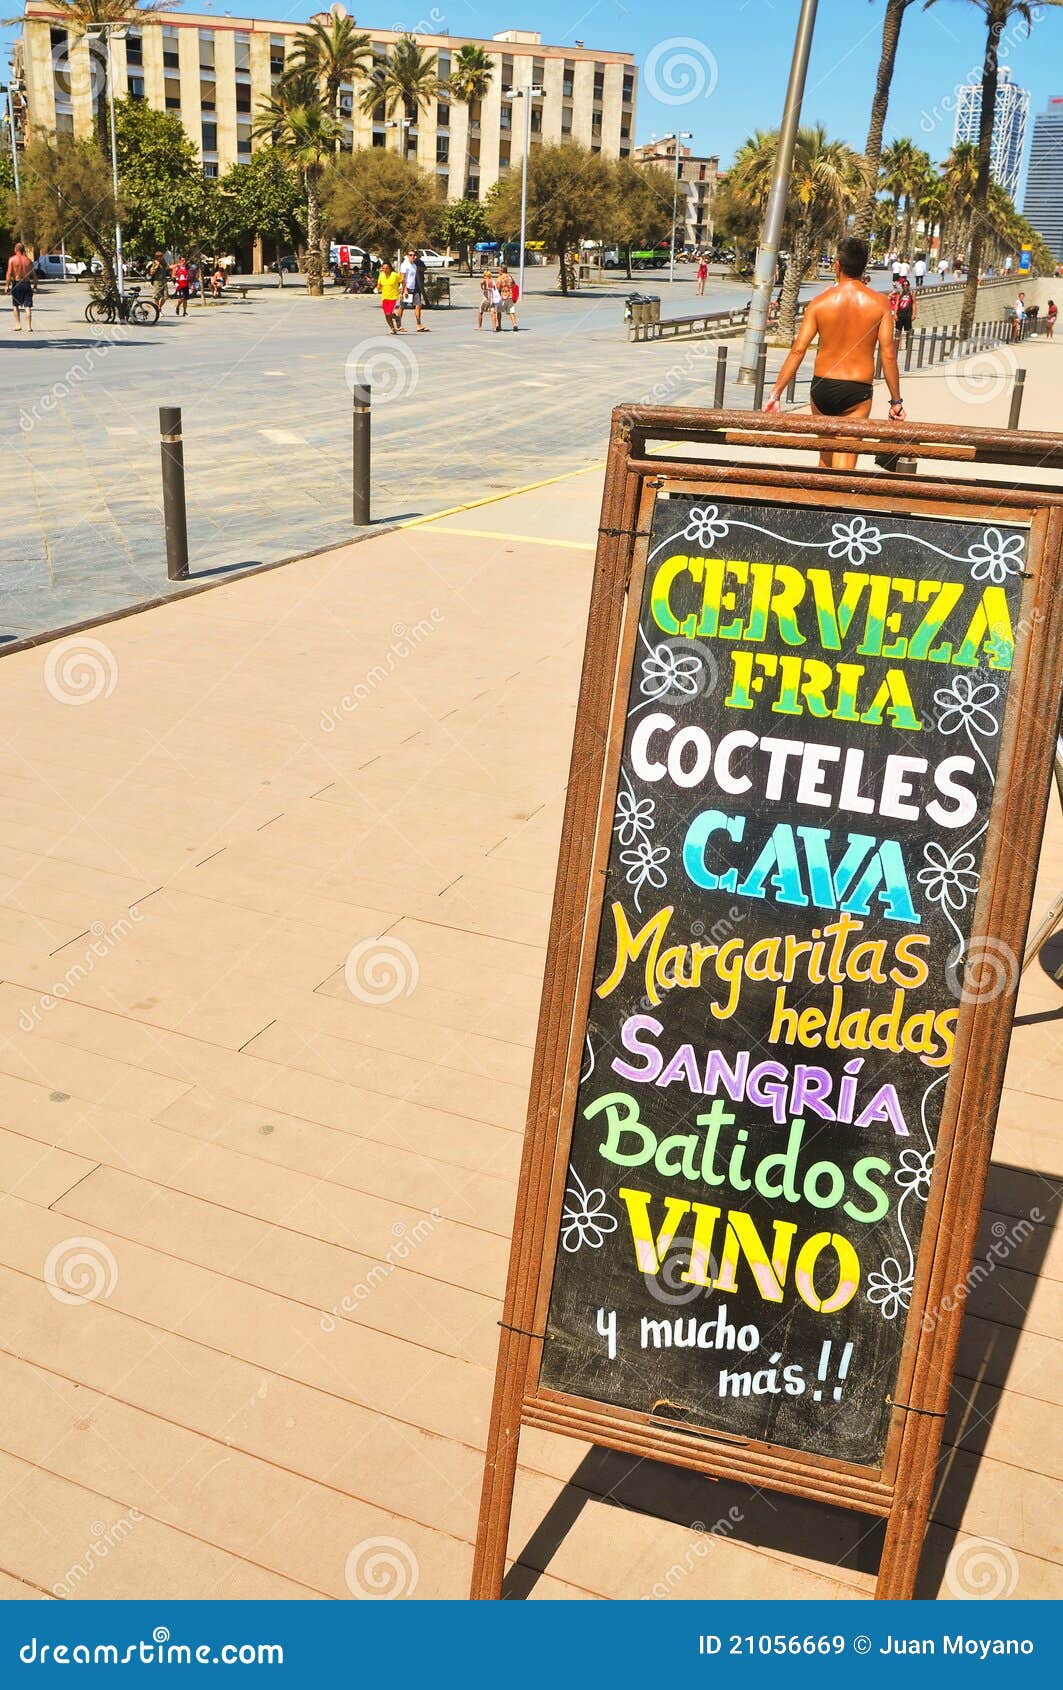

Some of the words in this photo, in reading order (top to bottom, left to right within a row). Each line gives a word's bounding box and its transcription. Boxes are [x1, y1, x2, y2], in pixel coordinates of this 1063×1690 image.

[651, 555, 1015, 671] CERVEZA
[725, 651, 922, 731] FRIA
[630, 712, 978, 830] COCTELES
[683, 809, 921, 925] CAVA
[596, 900, 930, 1020] Margaritas
[611, 1014, 909, 1137] SANGRÍA
[768, 986, 960, 1068] heladas
[583, 1092, 892, 1223] Batidos
[618, 1187, 861, 1314] VINO
[640, 1304, 760, 1352] mucho
